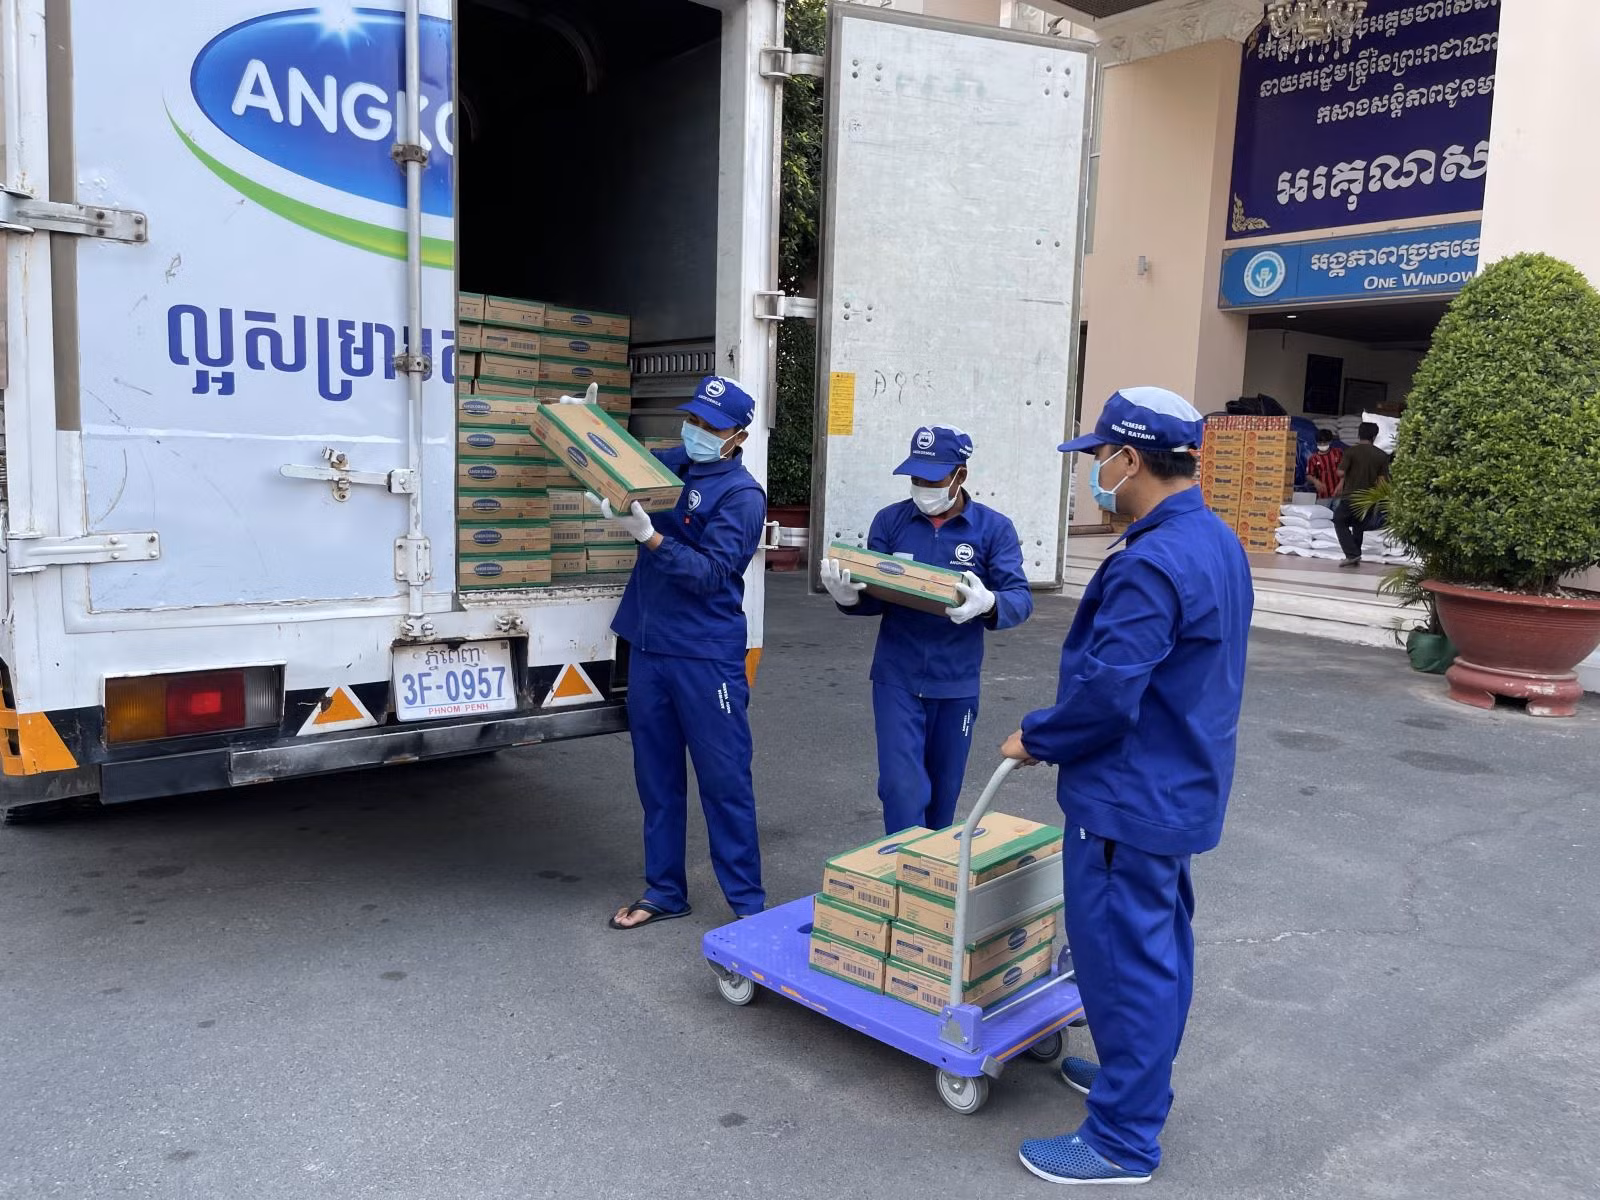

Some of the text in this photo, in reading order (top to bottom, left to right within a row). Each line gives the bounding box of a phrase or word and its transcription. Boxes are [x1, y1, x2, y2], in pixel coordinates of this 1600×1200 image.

[1363, 275, 1397, 290] ONE
[1111, 423, 1156, 441] SENG RATANA
[425, 646, 481, 671] ភ្នំពេញ
[402, 666, 506, 706] 3F-0957
[428, 702, 489, 715] PHNOM PENH
